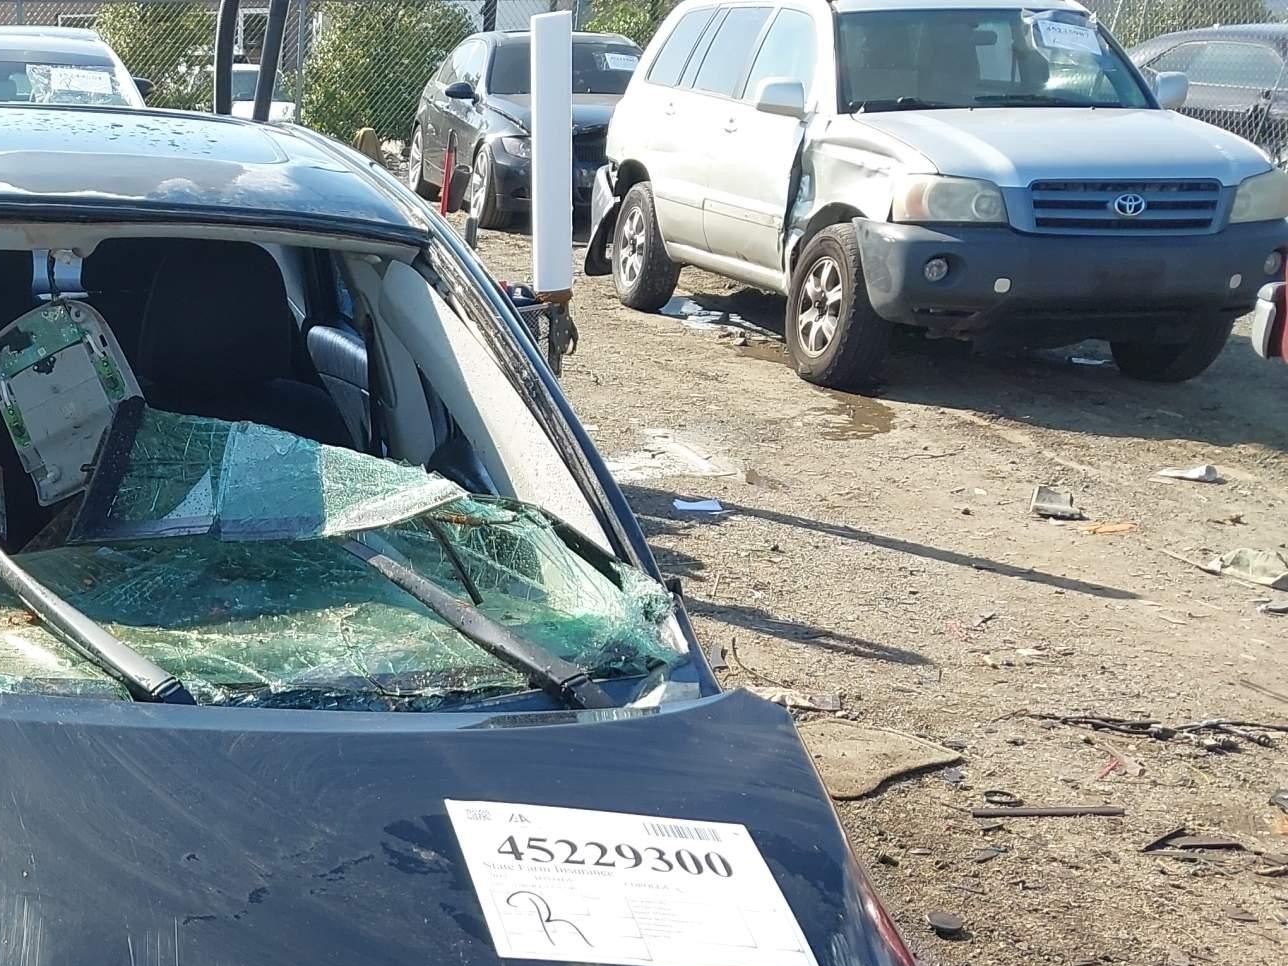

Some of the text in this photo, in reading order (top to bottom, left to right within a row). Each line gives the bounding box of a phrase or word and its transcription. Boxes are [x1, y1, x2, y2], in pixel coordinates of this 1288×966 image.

[482, 861, 614, 877] State Farm Insurance
[496, 834, 734, 878] 45229300
